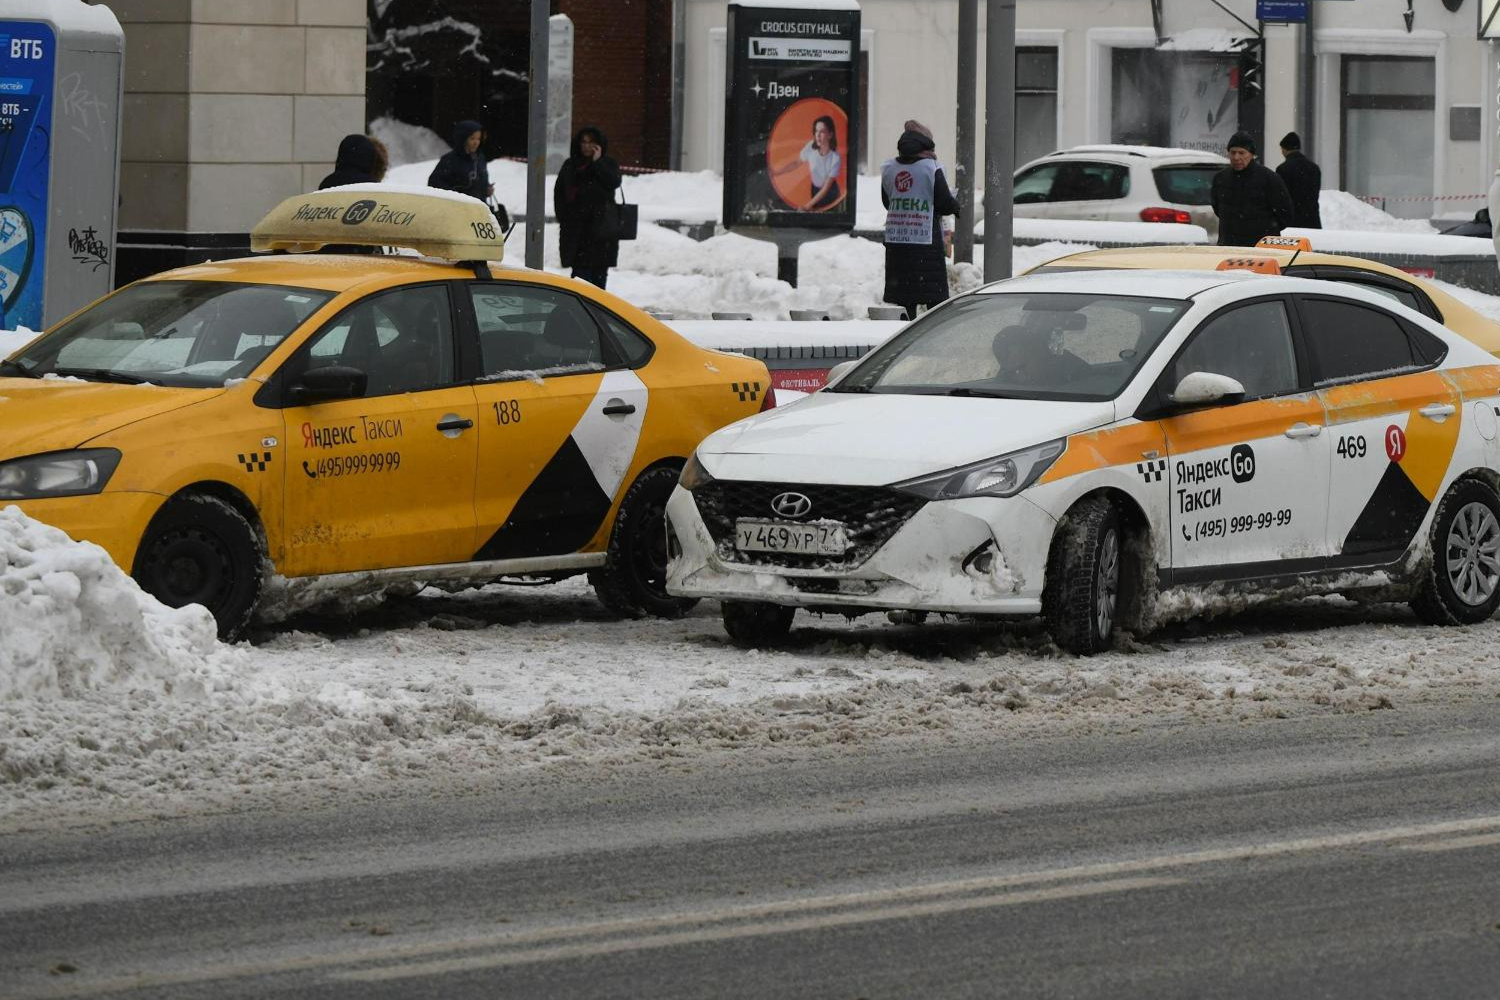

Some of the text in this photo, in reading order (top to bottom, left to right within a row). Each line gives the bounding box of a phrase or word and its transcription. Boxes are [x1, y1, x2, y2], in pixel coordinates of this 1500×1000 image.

[761, 21, 841, 35] CROCUS CITY HALL
[10, 38, 43, 59] ВТБ
[768, 82, 800, 99] Дзен
[2, 103, 20, 115] ВТБ
[291, 202, 416, 226] Яндекс Go Такси
[470, 222, 496, 240] 188
[493, 400, 521, 426] 188
[302, 415, 403, 449] Яндекс Такси
[1336, 435, 1367, 459] 469
[1176, 451, 1253, 485] Яндекс Go
[1177, 487, 1221, 514] Такси
[1195, 509, 1292, 541] (495) 999-99-99
